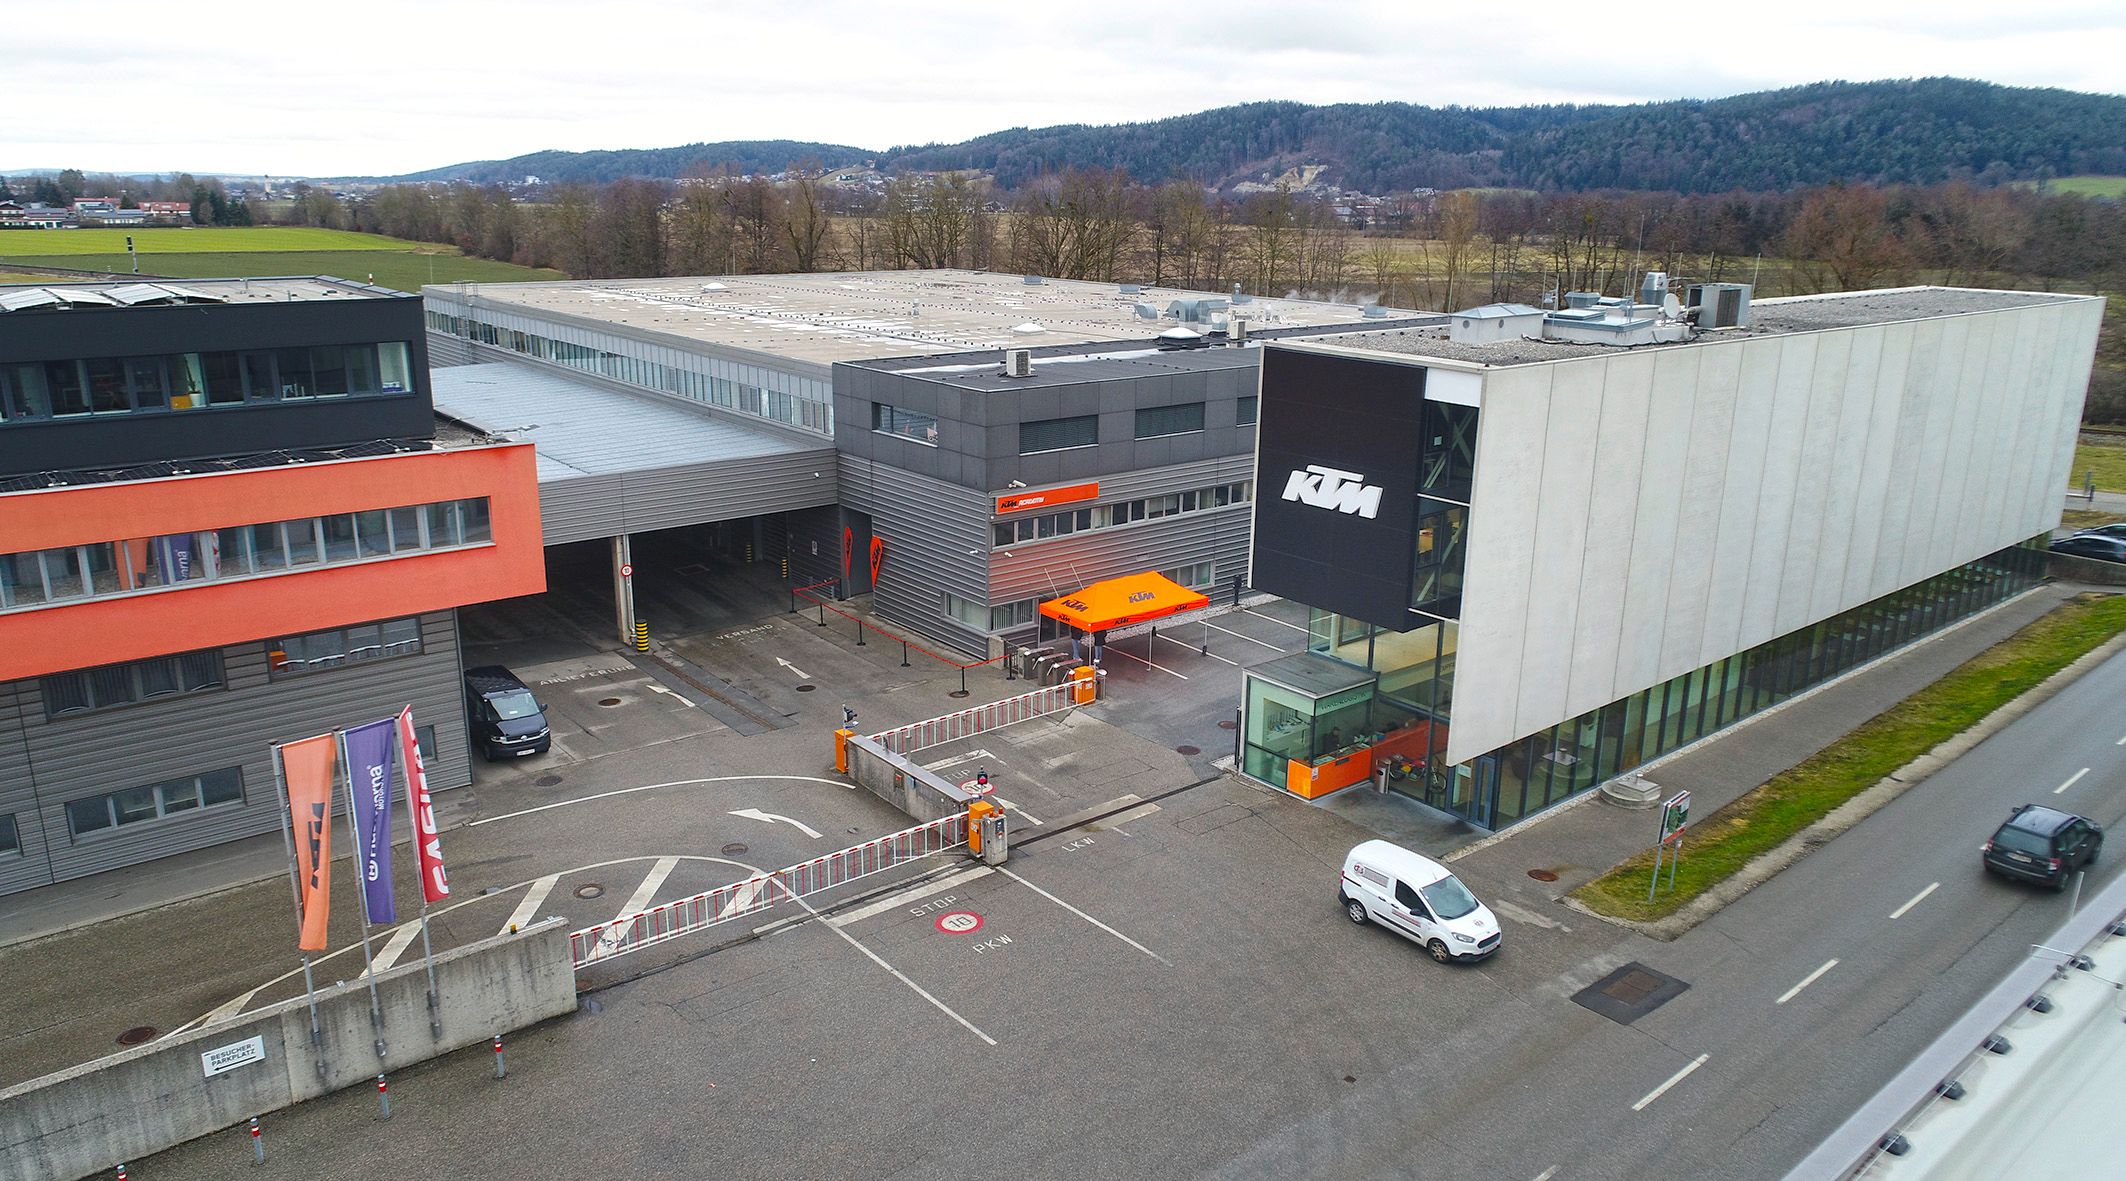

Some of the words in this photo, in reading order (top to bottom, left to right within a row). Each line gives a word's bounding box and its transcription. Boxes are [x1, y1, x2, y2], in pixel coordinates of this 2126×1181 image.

[1281, 464, 1384, 520] KTM
[1001, 500, 1017, 509] KTM
[1128, 591, 1157, 604] KTM
[1061, 599, 1089, 613] KTM
[1058, 614, 1071, 623] KTM
[715, 624, 774, 640] VERSAND
[540, 665, 637, 686] ANLIEFERUNG
[1061, 836, 1096, 852] LKW
[910, 895, 957, 917] STOP
[949, 916, 973, 928] 10
[972, 933, 1013, 954] PKW
[211, 1043, 255, 1061] BESUCHER-
[212, 1048, 256, 1067] PARKPLATZ
